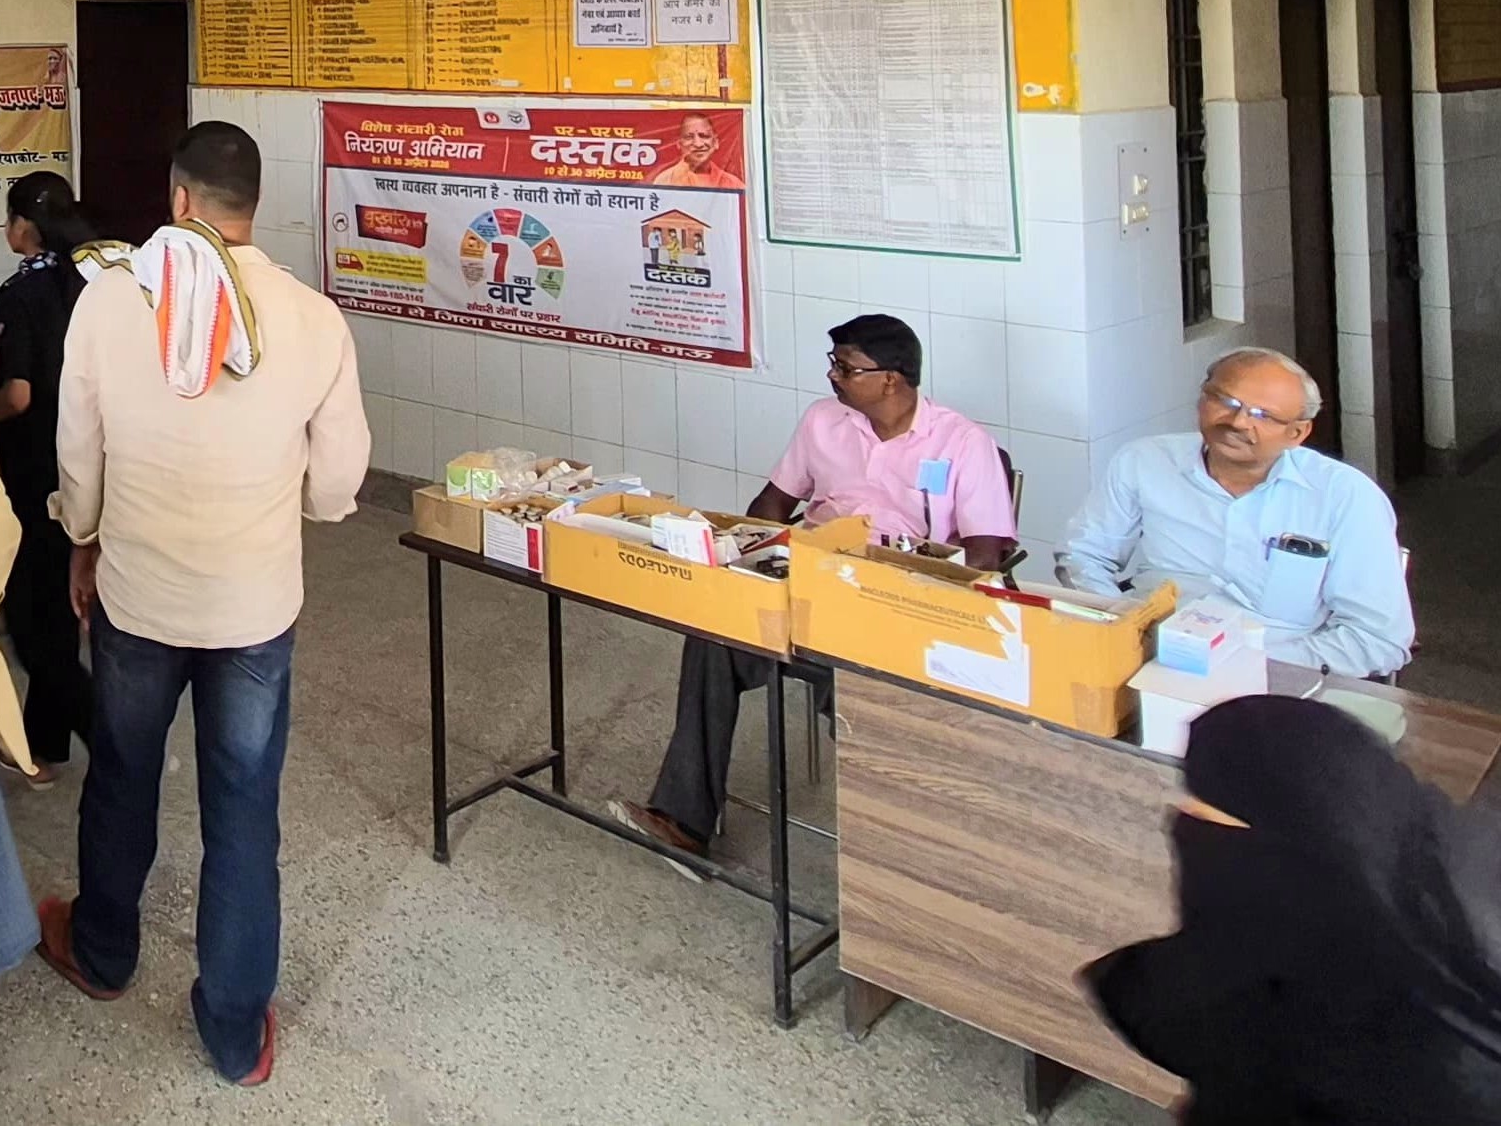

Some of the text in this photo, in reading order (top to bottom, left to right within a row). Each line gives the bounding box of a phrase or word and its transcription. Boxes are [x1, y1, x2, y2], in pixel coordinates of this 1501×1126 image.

[438, 123, 464, 137] रोग
[344, 130, 486, 161] नियंत्रण अभियान
[529, 135, 662, 167] दस्तक
[557, 165, 567, 175] से
[441, 182, 487, 199] अपनाना
[489, 183, 500, 200] है
[584, 189, 602, 207] को
[608, 193, 646, 211] हराना
[649, 192, 660, 212] है
[491, 242, 531, 286] 7 का
[645, 268, 709, 286] दस्तक
[486, 281, 536, 306] वार
[618, 551, 692, 581] MACLEODS
